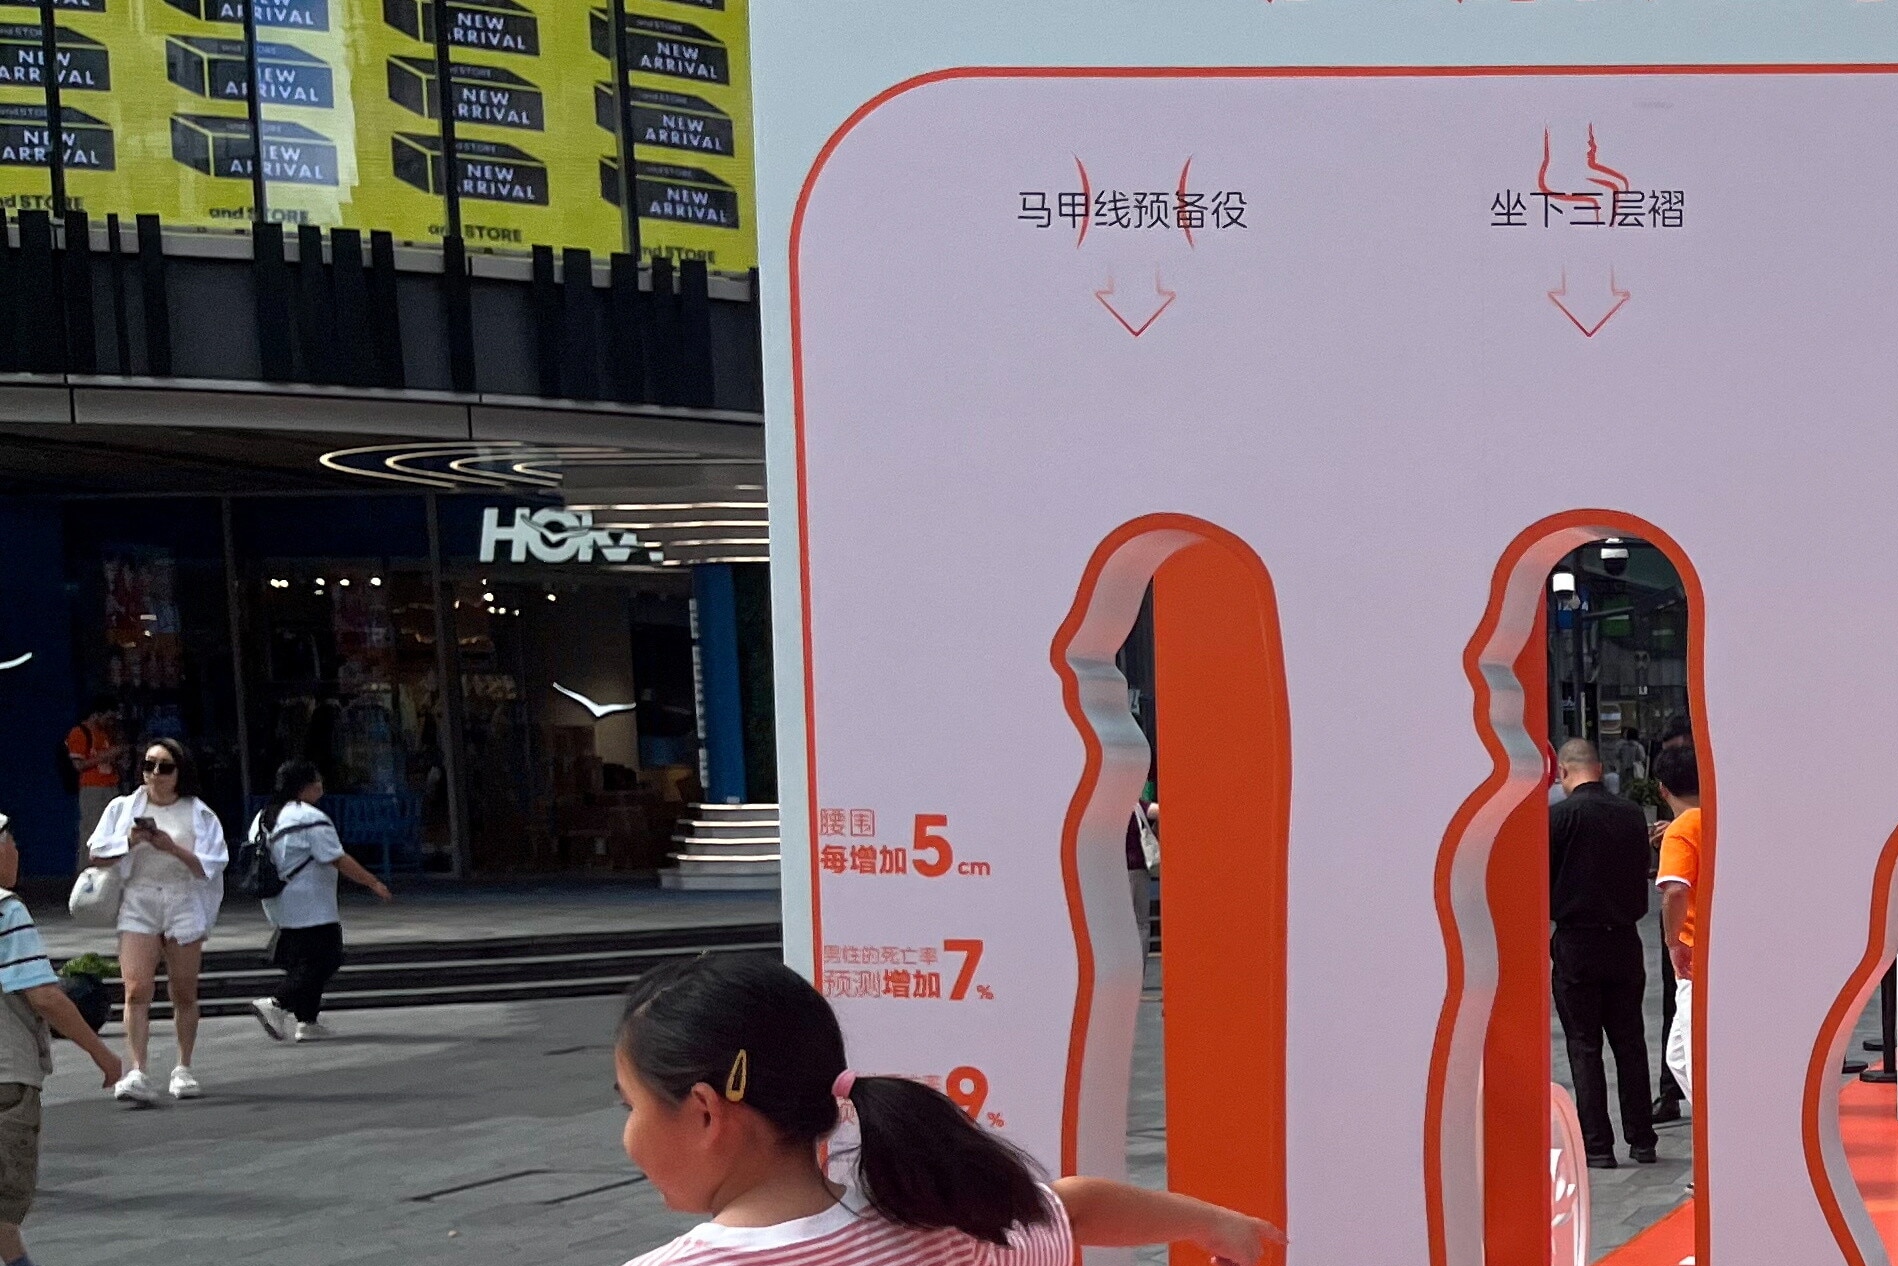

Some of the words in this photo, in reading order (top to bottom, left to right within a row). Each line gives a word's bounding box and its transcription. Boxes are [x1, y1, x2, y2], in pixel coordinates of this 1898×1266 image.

[457, 12, 504, 30] NEW
[448, 25, 526, 50] RRIVAL
[657, 42, 698, 60] NEW
[0, 65, 95, 85] ARRVAL
[257, 67, 296, 84] EW
[640, 54, 717, 79] ARRIVAL
[462, 88, 509, 105] NEW
[452, 103, 530, 125] RRIVAL
[662, 114, 704, 132] NEW
[645, 127, 722, 151] ARRIVAL
[2, 146, 100, 165] ARRVAL
[262, 145, 301, 161] EW
[467, 163, 514, 182] NEW
[457, 179, 535, 200] RRIVAL
[667, 187, 709, 206] NEW
[209, 206, 244, 219] and
[650, 200, 726, 223] ARRIVAL
[1016, 190, 1249, 230] 马甲线预备役
[1489, 189, 1686, 230] 坐下三层褶
[464, 225, 522, 243] STORE
[819, 808, 876, 838] 腰围
[824, 944, 938, 966] 男性的死亡率
